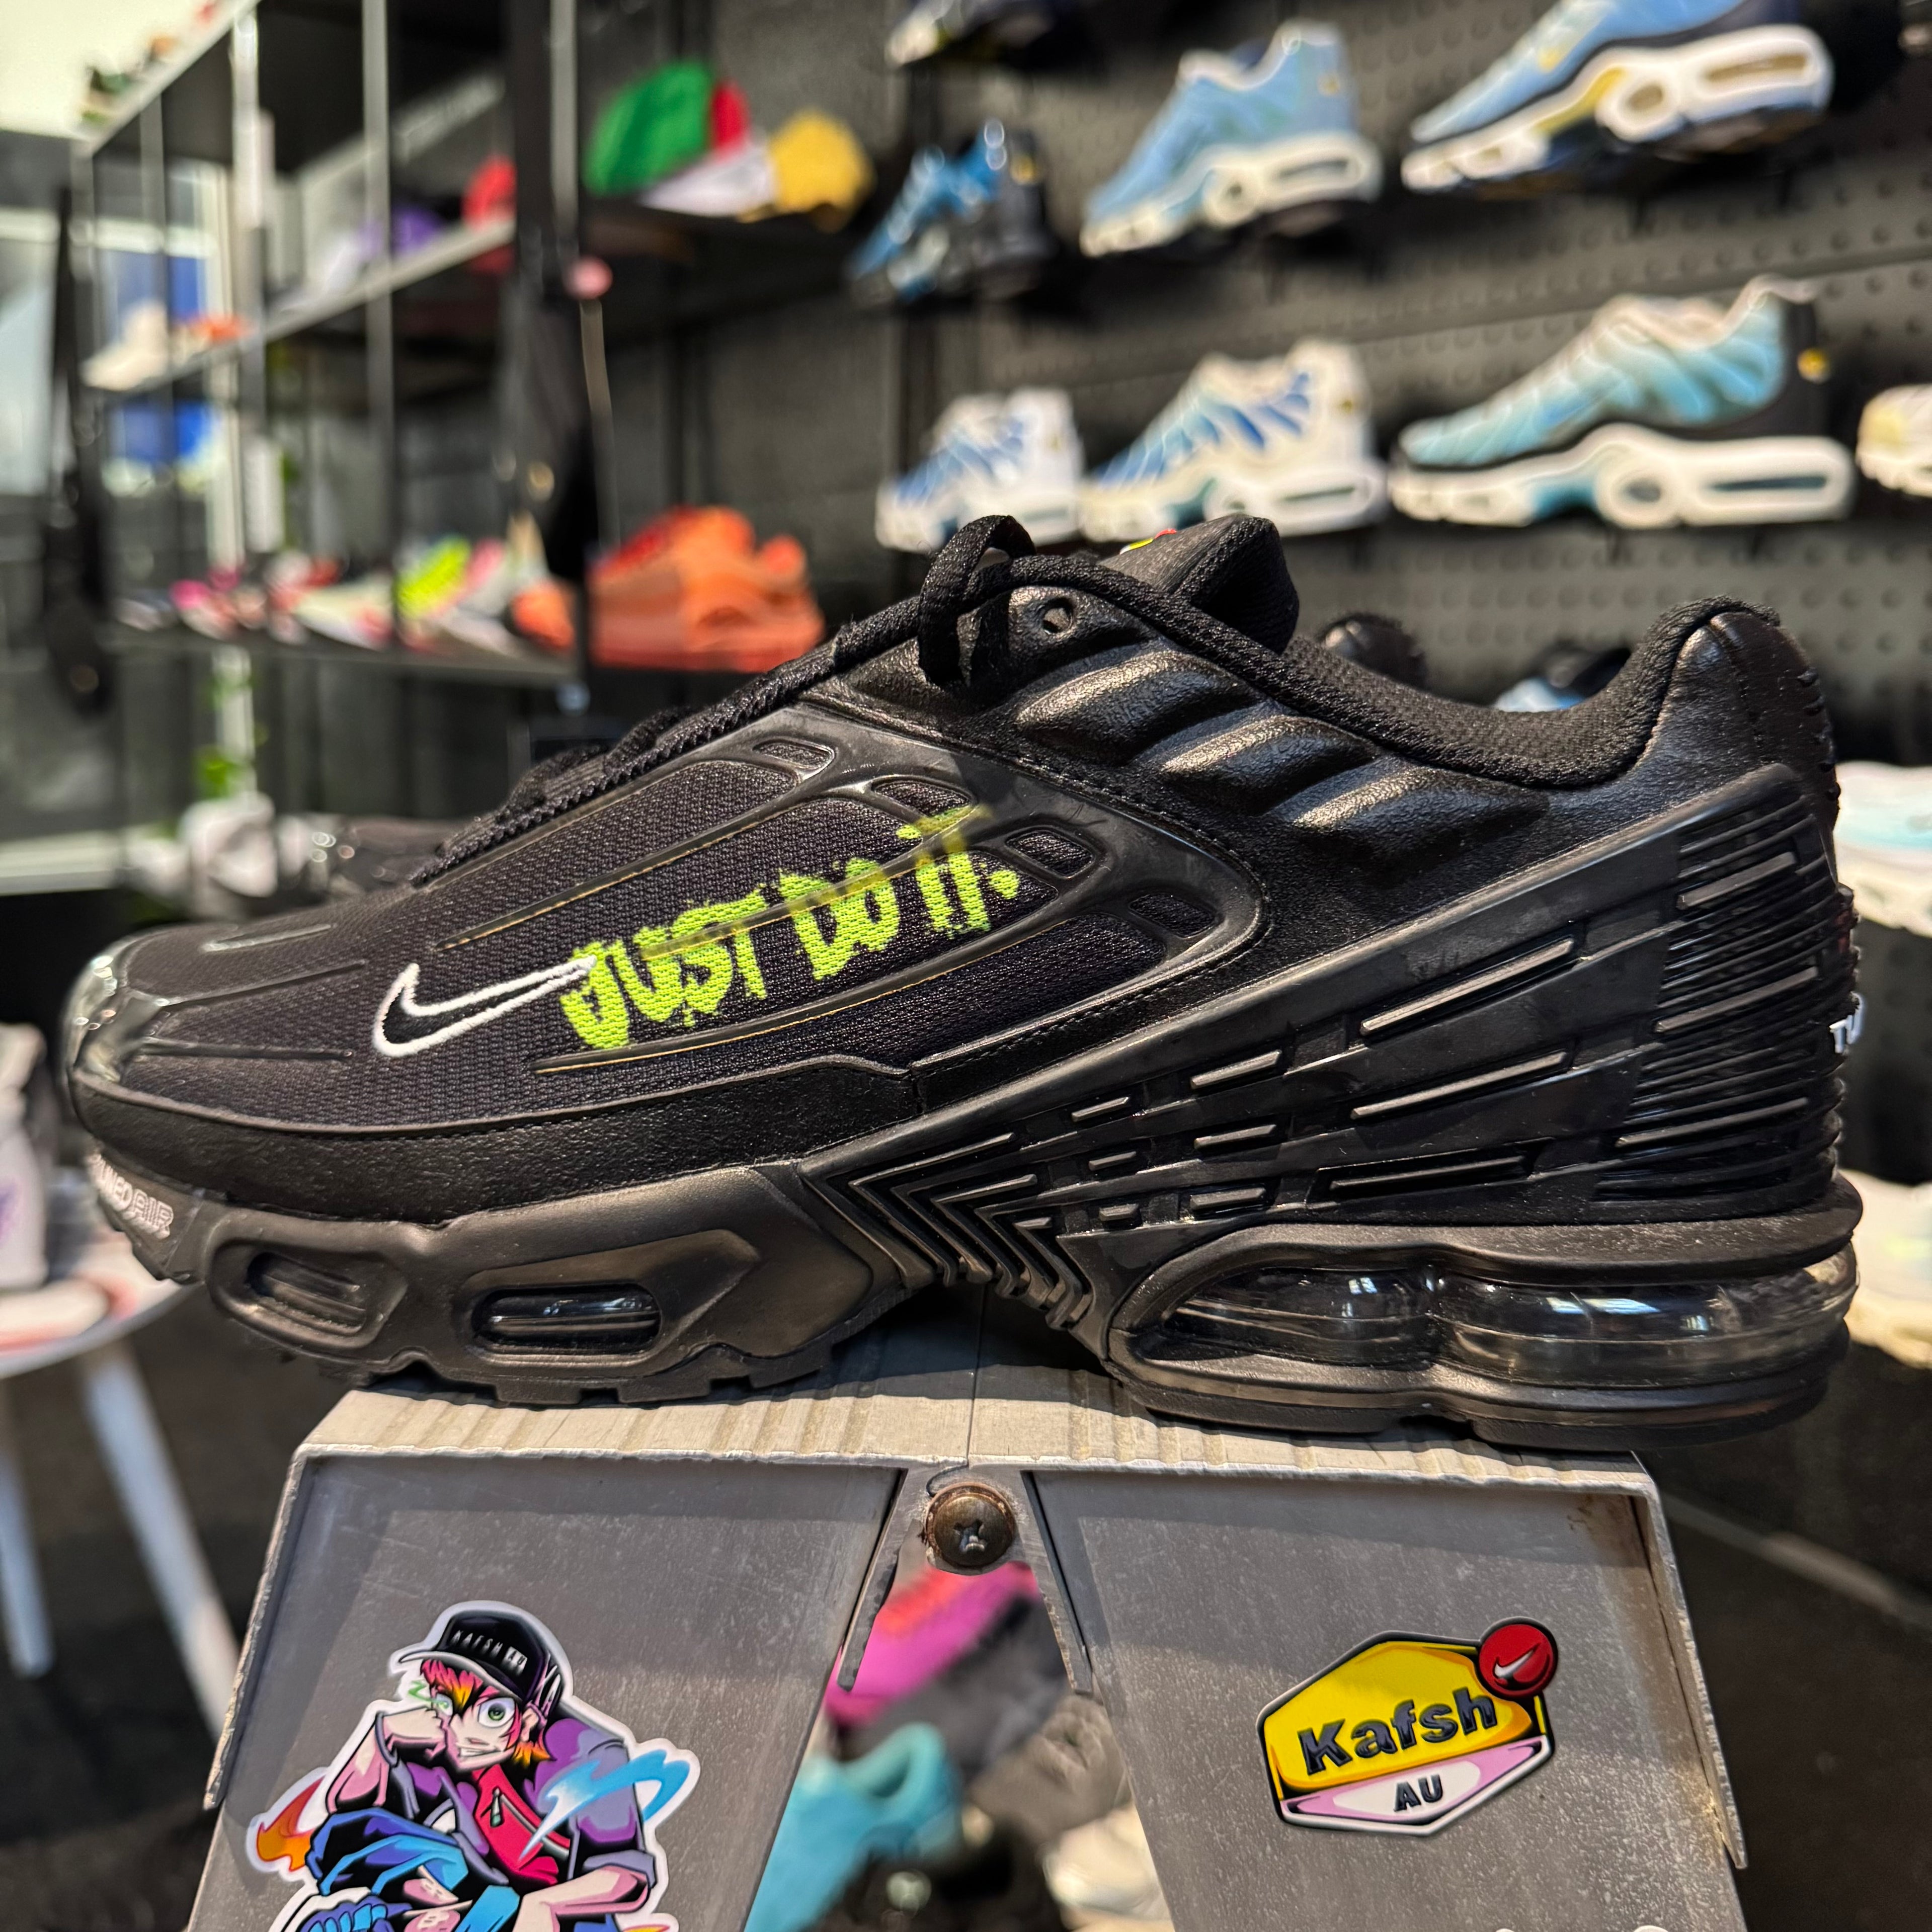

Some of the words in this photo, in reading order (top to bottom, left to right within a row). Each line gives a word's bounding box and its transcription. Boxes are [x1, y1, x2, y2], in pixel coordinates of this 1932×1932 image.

[123, 1188, 174, 1239] AIR
[505, 1647, 527, 1669] AU
[1297, 1686, 1498, 1777] Kafsh
[1393, 1774, 1444, 1812] AU
